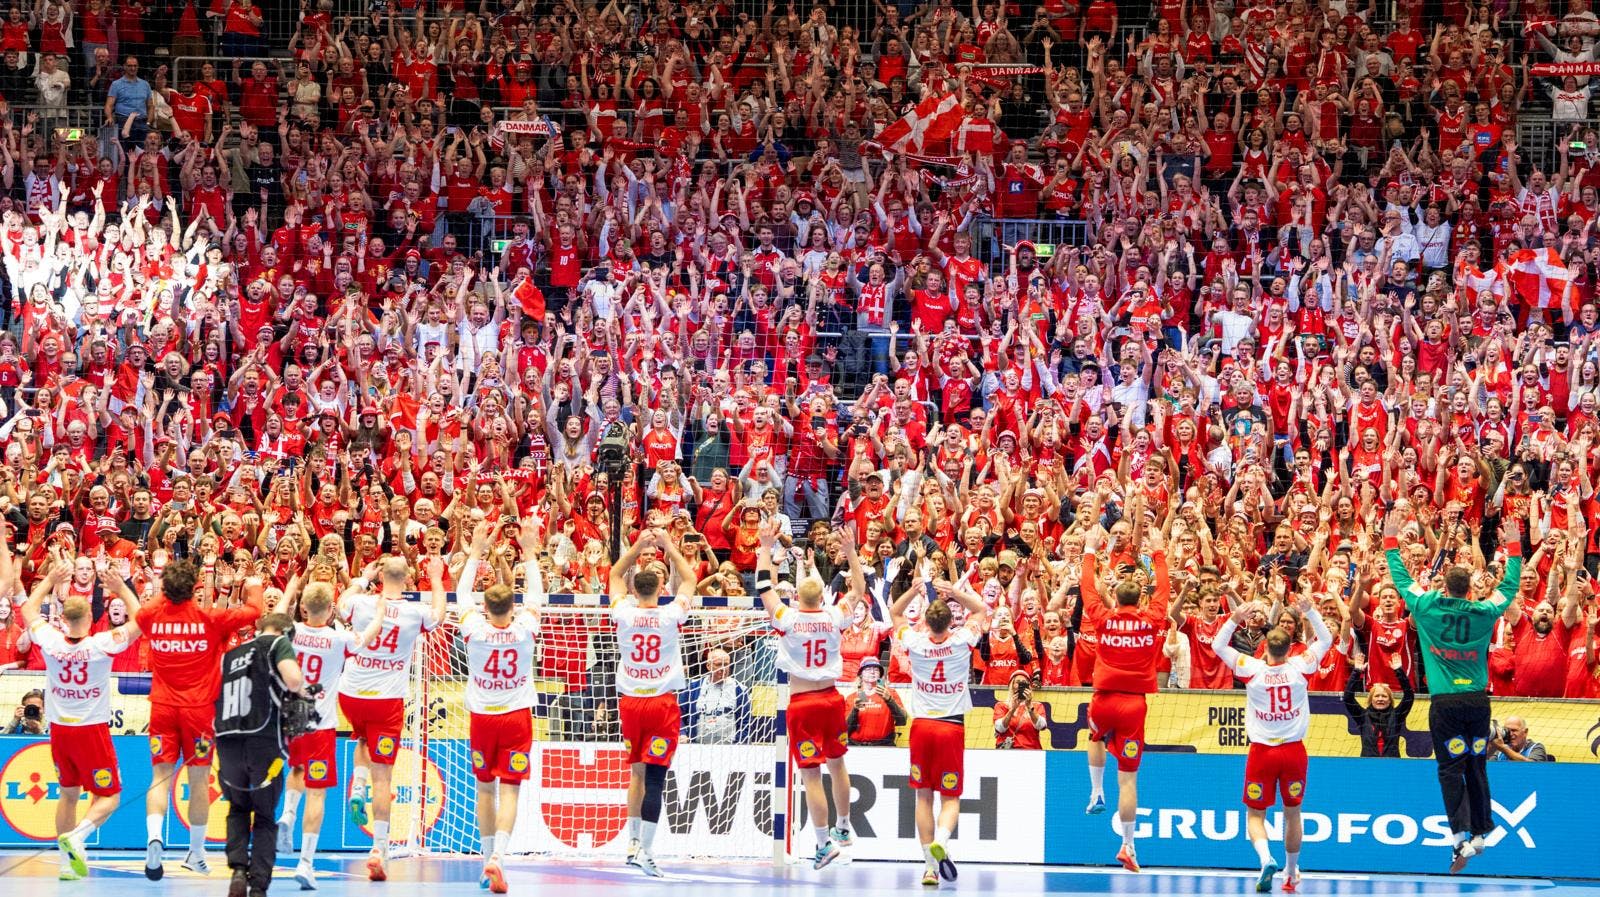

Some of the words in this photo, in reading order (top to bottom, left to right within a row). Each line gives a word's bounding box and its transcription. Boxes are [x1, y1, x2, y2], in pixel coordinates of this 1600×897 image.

[1549, 64, 1600, 74] DANMAR
[505, 122, 548, 133] DANMAR
[560, 255, 569, 266] 10
[526, 356, 533, 366] 5
[2, 371, 8, 382] 6
[151, 622, 206, 636] DANMARK
[1106, 619, 1153, 631] DANMARK
[1441, 614, 1471, 645] 20
[150, 639, 208, 653] NORLYS
[293, 633, 333, 649] NDERSEN
[1100, 633, 1154, 648] NORLYS
[631, 633, 661, 664] 38
[802, 639, 827, 668] 15
[353, 654, 405, 671] NORLYS
[483, 648, 518, 679] 43
[59, 660, 88, 686] 33
[931, 660, 946, 682] 4
[474, 675, 527, 690] NORLYS
[917, 681, 964, 694] NORLYS
[52, 687, 101, 699] NORLYS
[1265, 685, 1291, 713] 19
[1208, 707, 1245, 726] PURE
[1111, 808, 1453, 847] GRUNDFOS
